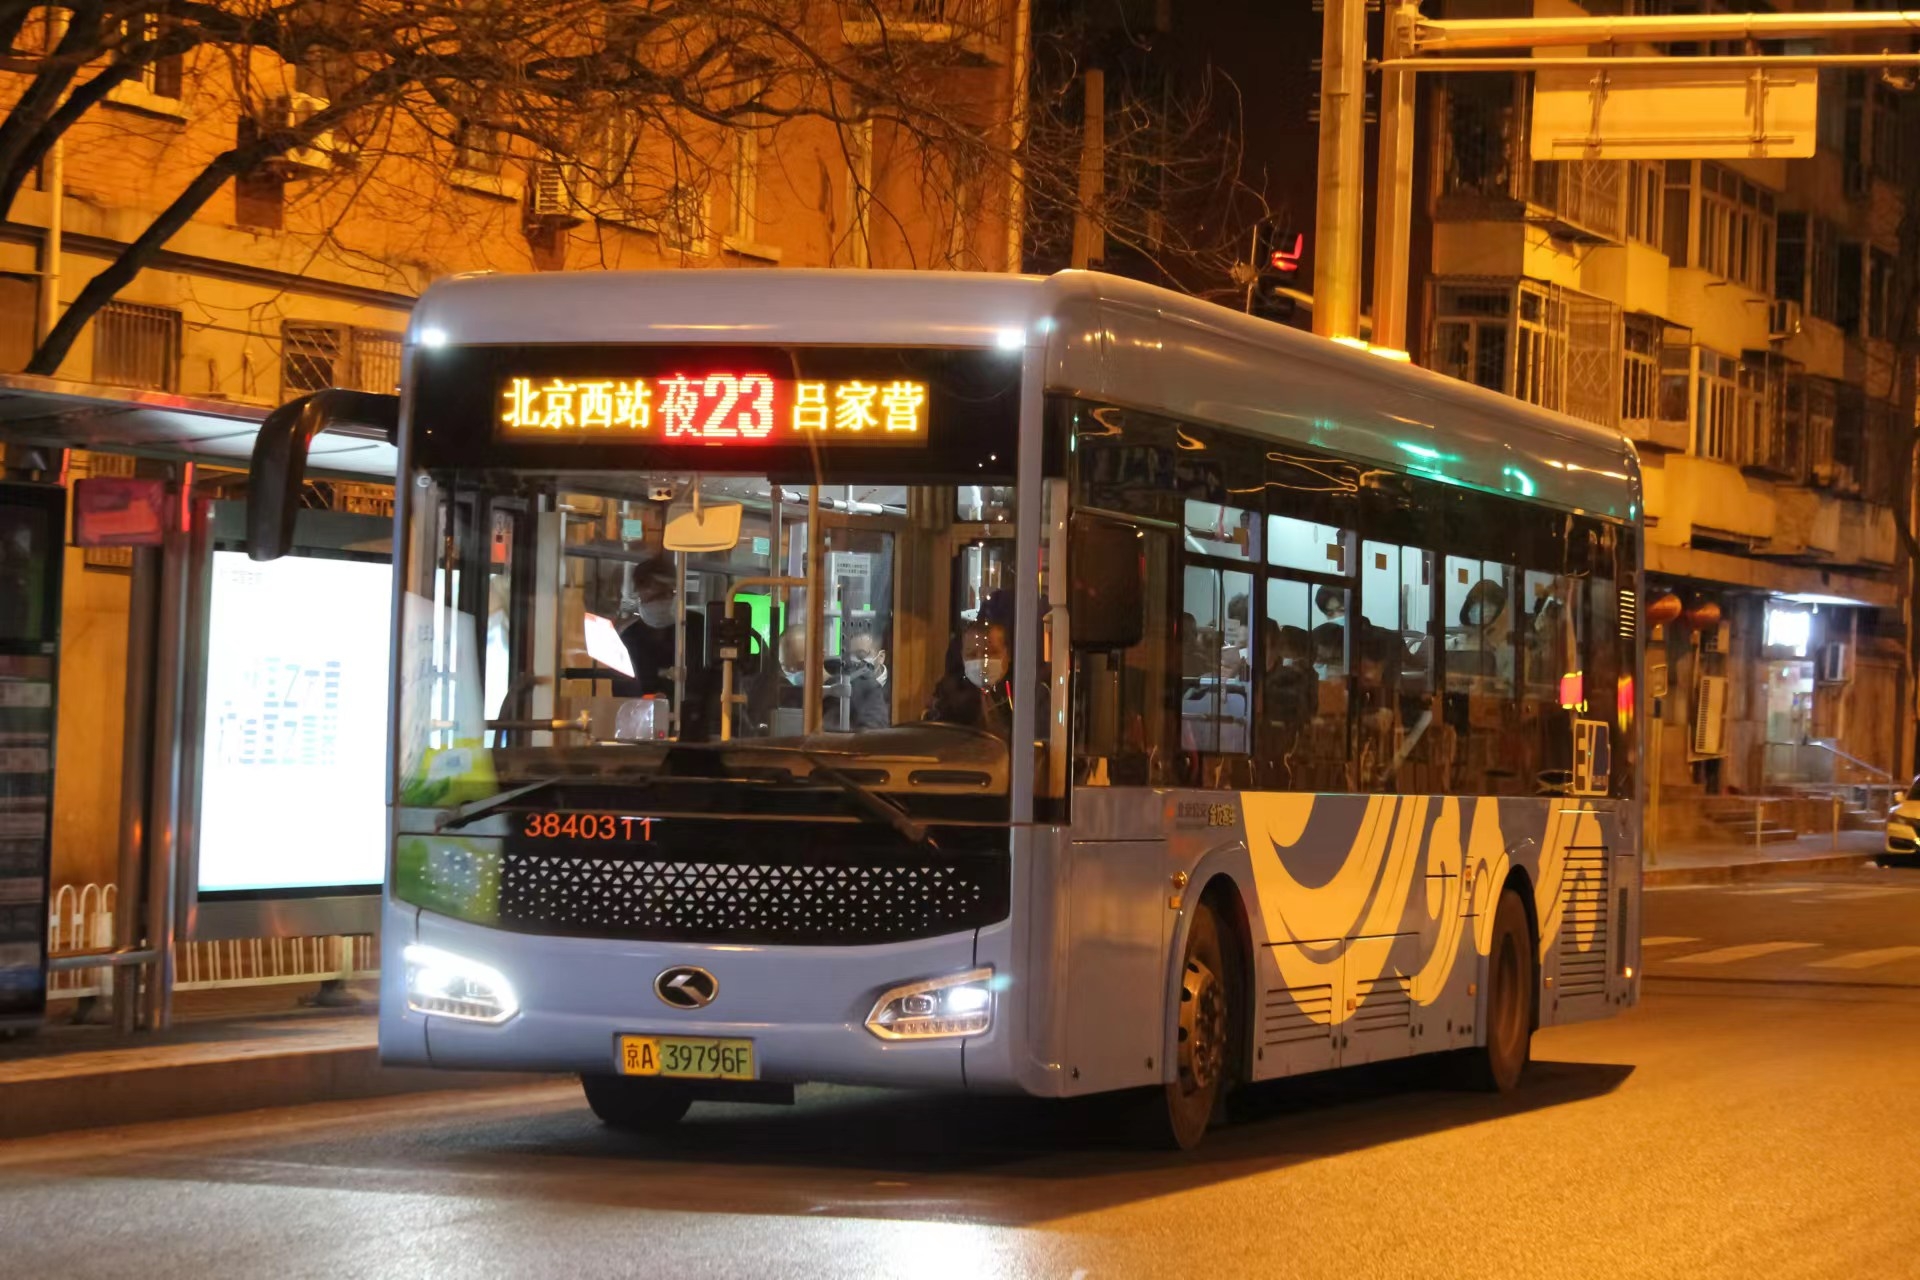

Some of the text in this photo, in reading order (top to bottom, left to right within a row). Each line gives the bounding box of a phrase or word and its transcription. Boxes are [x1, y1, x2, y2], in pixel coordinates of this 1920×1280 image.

[502, 373, 925, 438] 北京西站 夜23 吕家营
[524, 812, 651, 841] 3840311
